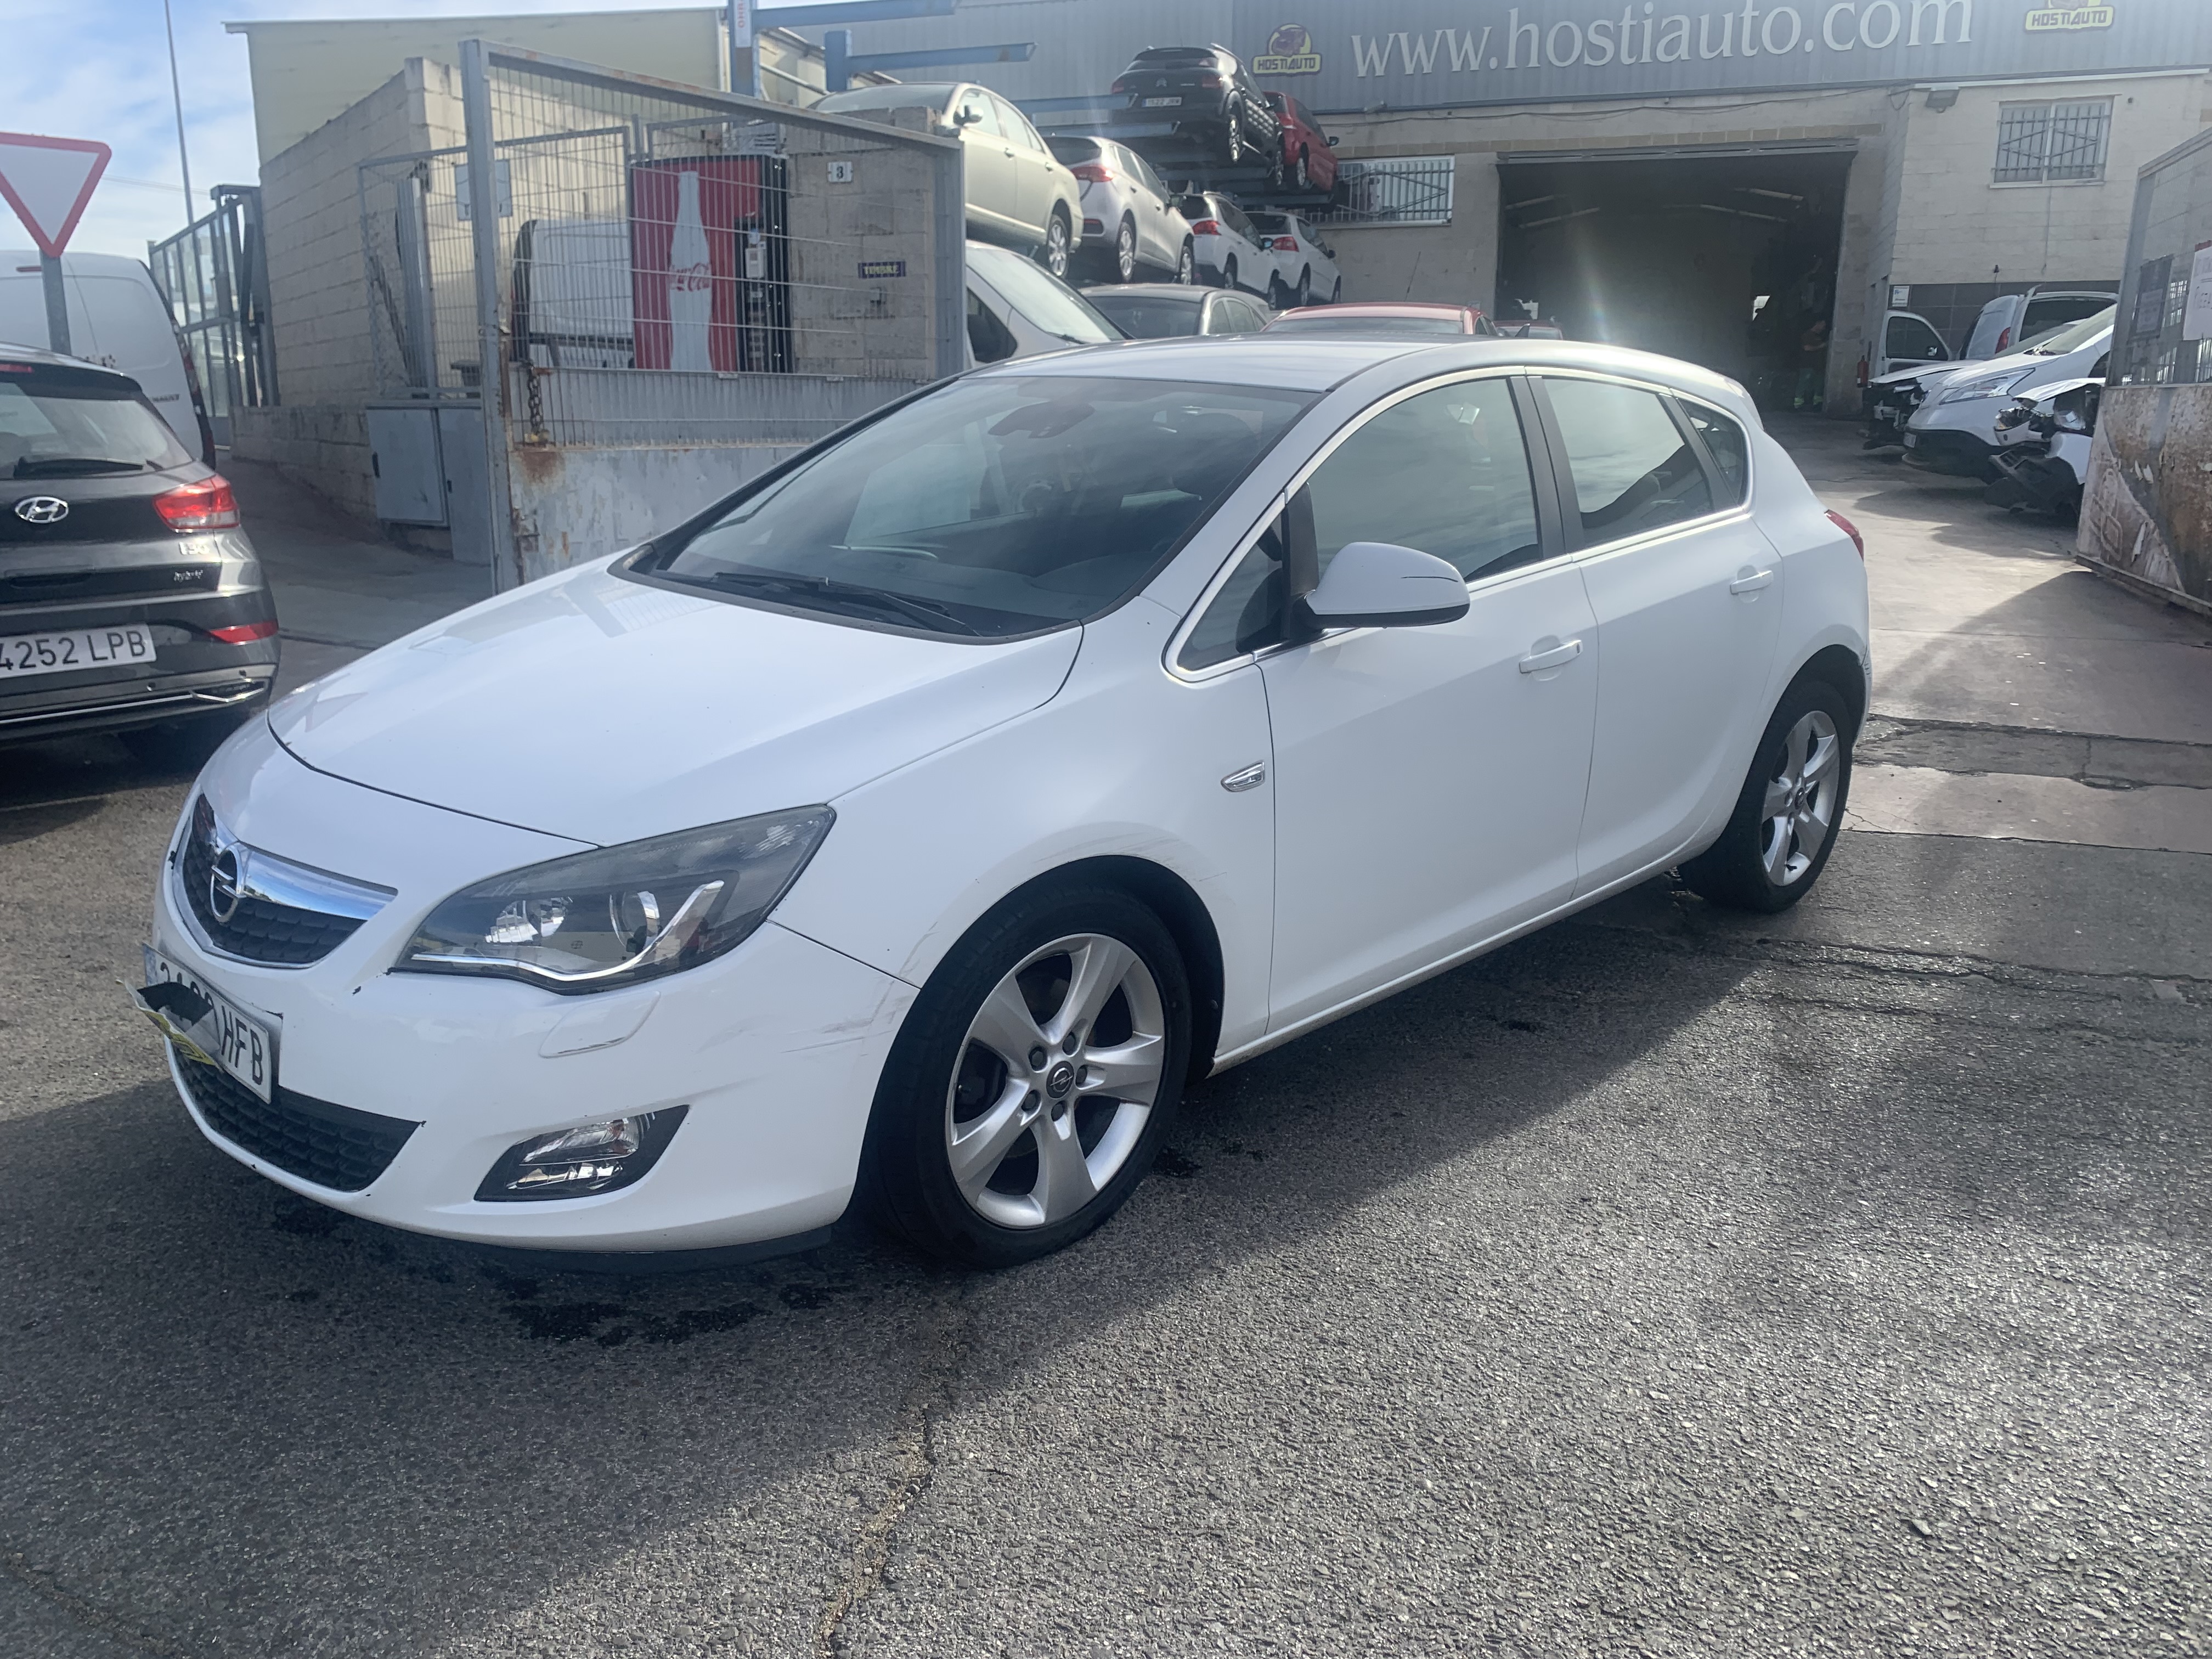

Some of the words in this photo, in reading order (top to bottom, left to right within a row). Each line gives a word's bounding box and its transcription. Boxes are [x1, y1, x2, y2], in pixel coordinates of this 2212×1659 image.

[2032, 10, 2108, 26] HOSTIAUTO
[1351, 0, 1973, 77] www.hostiauto.com
[1257, 58, 1316, 70] HOSTIAUTO
[836, 166, 844, 179] 3
[0, 637, 78, 671] 4252
[87, 631, 145, 662] LPB
[221, 1005, 263, 1085] HFB
